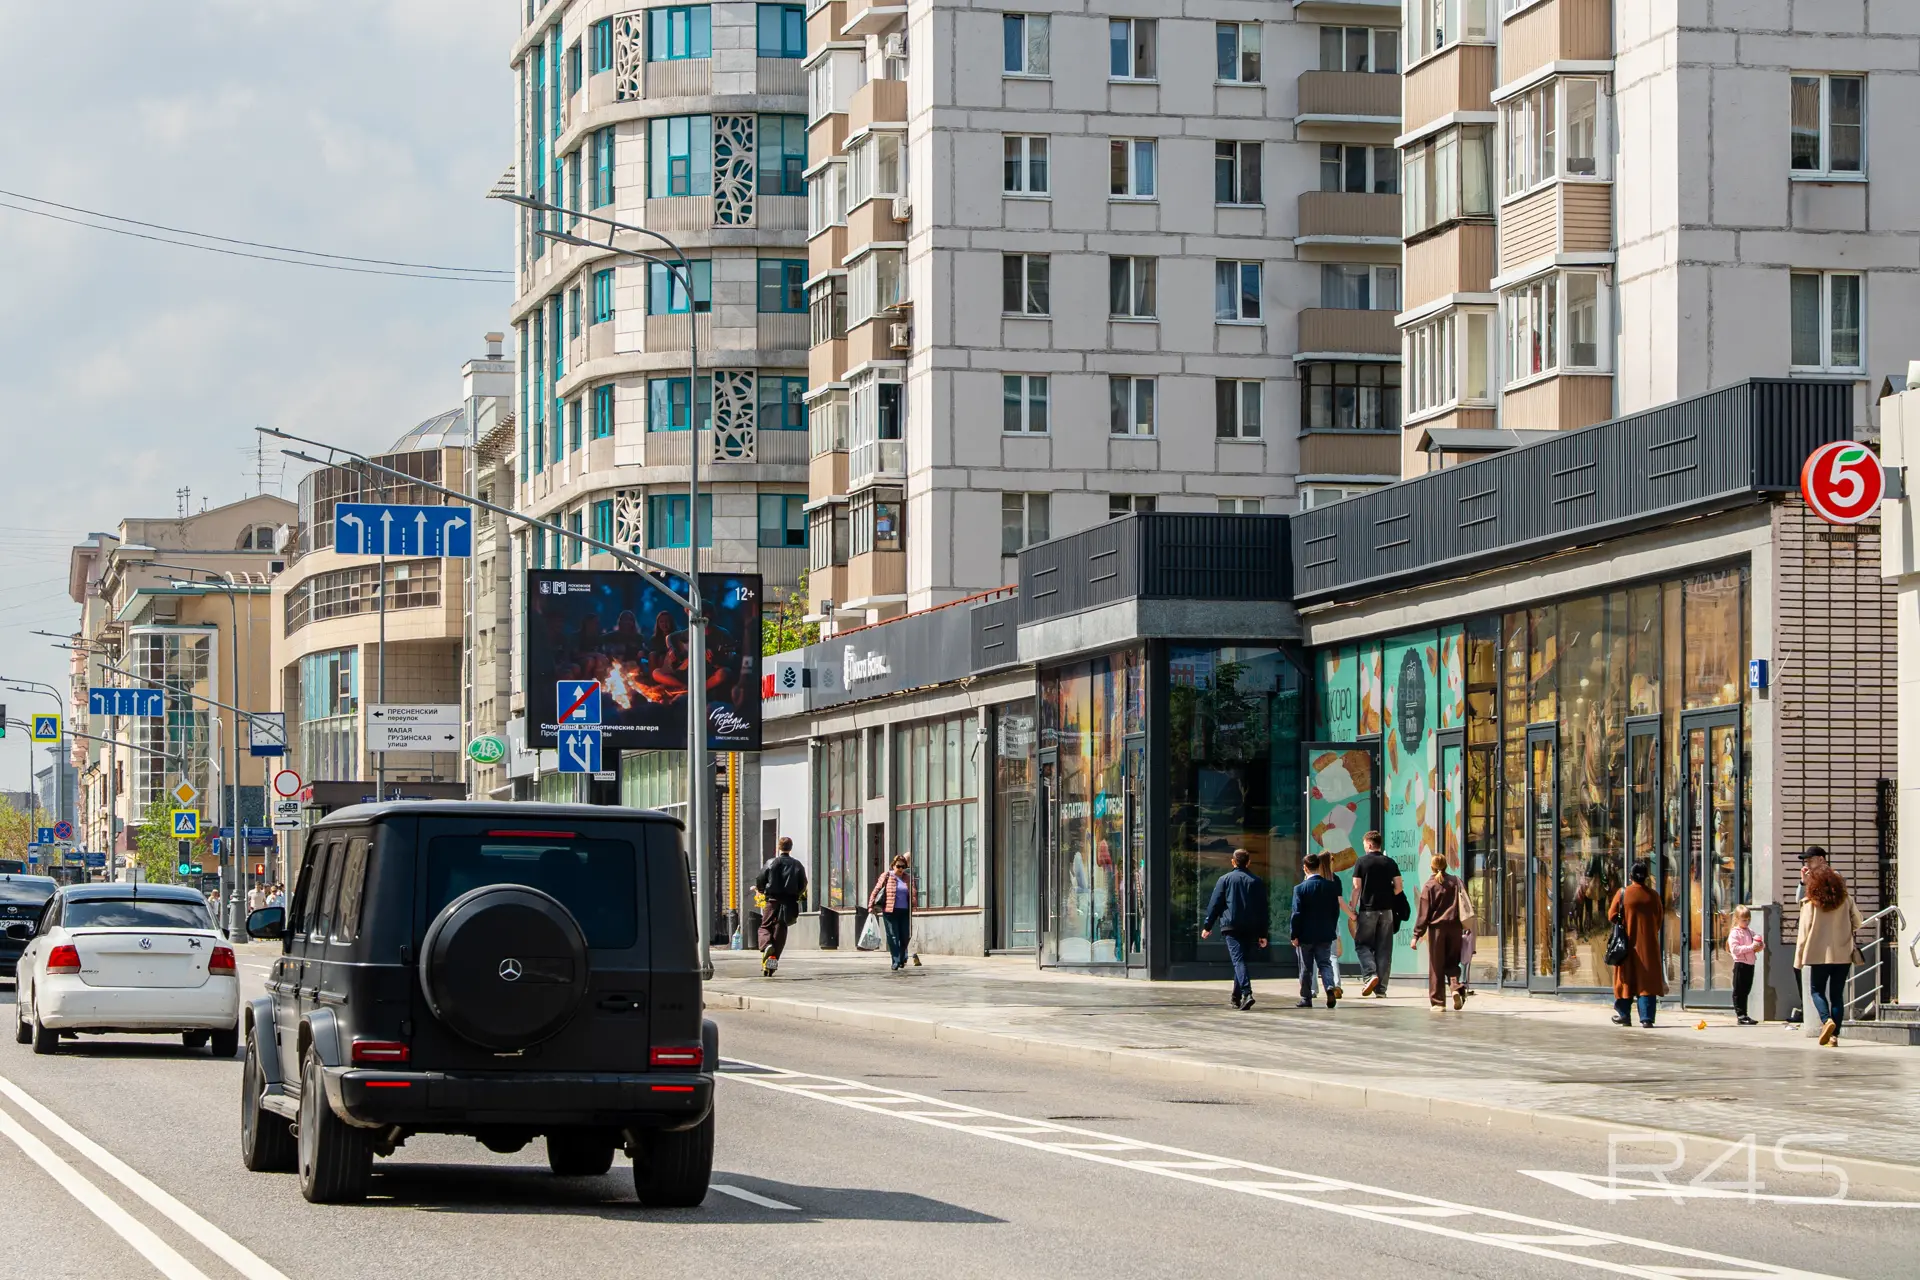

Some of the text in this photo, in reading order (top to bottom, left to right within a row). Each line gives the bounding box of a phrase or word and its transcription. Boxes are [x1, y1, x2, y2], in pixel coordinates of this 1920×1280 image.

[1828, 446, 1868, 508] 5
[735, 587, 755, 601] 12+
[1750, 665, 1759, 683] 12
